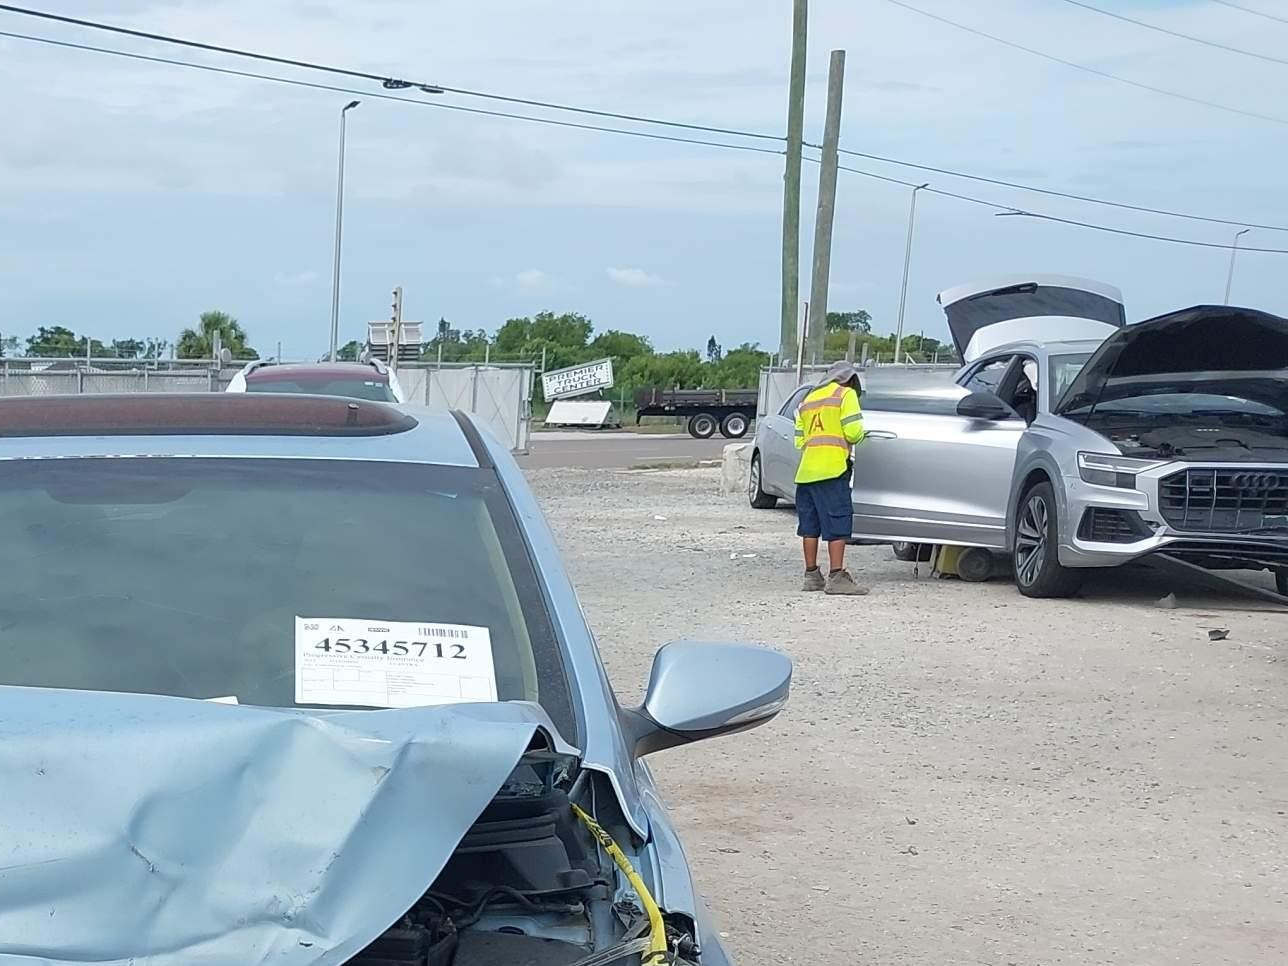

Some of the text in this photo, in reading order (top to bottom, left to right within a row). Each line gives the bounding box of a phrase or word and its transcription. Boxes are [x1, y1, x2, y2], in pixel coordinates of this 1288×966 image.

[549, 365, 603, 382] PREMIER
[558, 372, 596, 386] TRUCK
[554, 378, 601, 394] CENTER
[315, 637, 467, 660] 45345712
